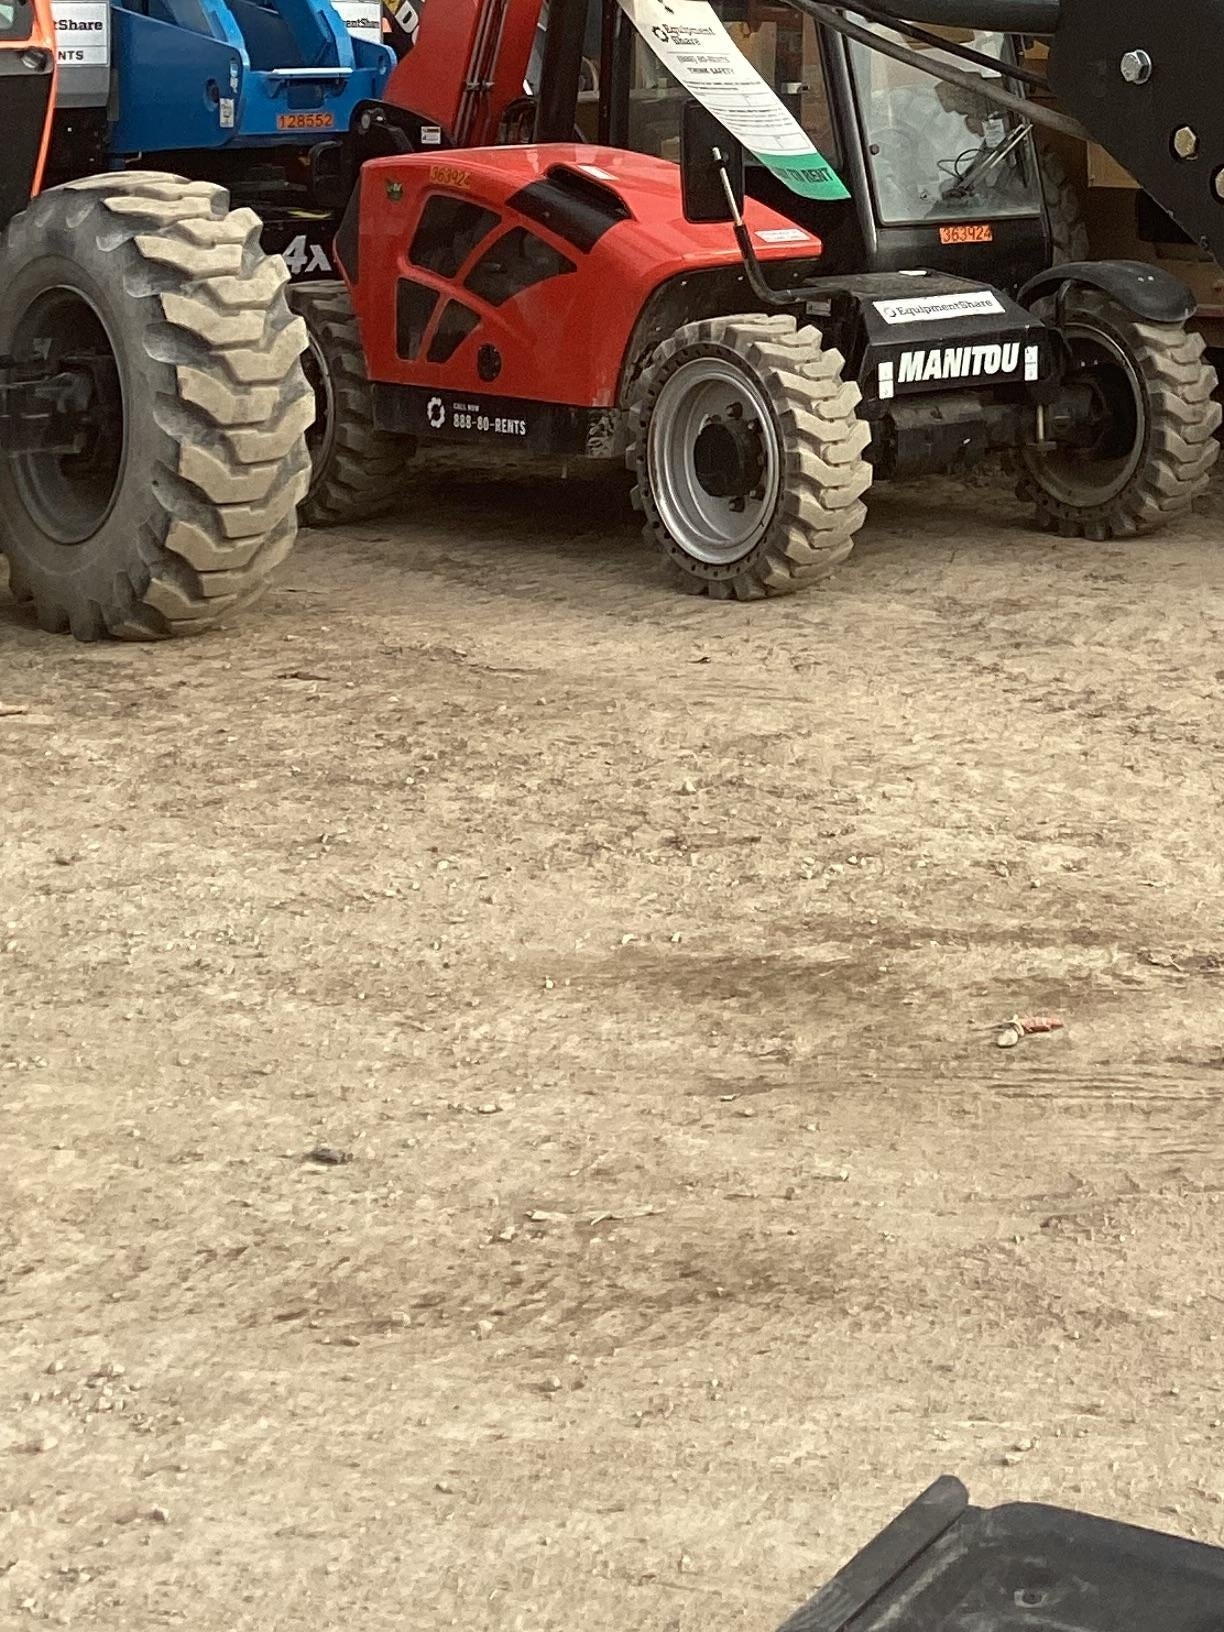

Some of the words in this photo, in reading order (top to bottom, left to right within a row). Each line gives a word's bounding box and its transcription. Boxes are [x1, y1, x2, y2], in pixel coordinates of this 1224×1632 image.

[278, 115, 334, 129] 128552
[895, 298, 994, 317] EquipmentShare
[897, 342, 1021, 383] MANITOU
[453, 413, 526, 435] 888-80-RENTS
